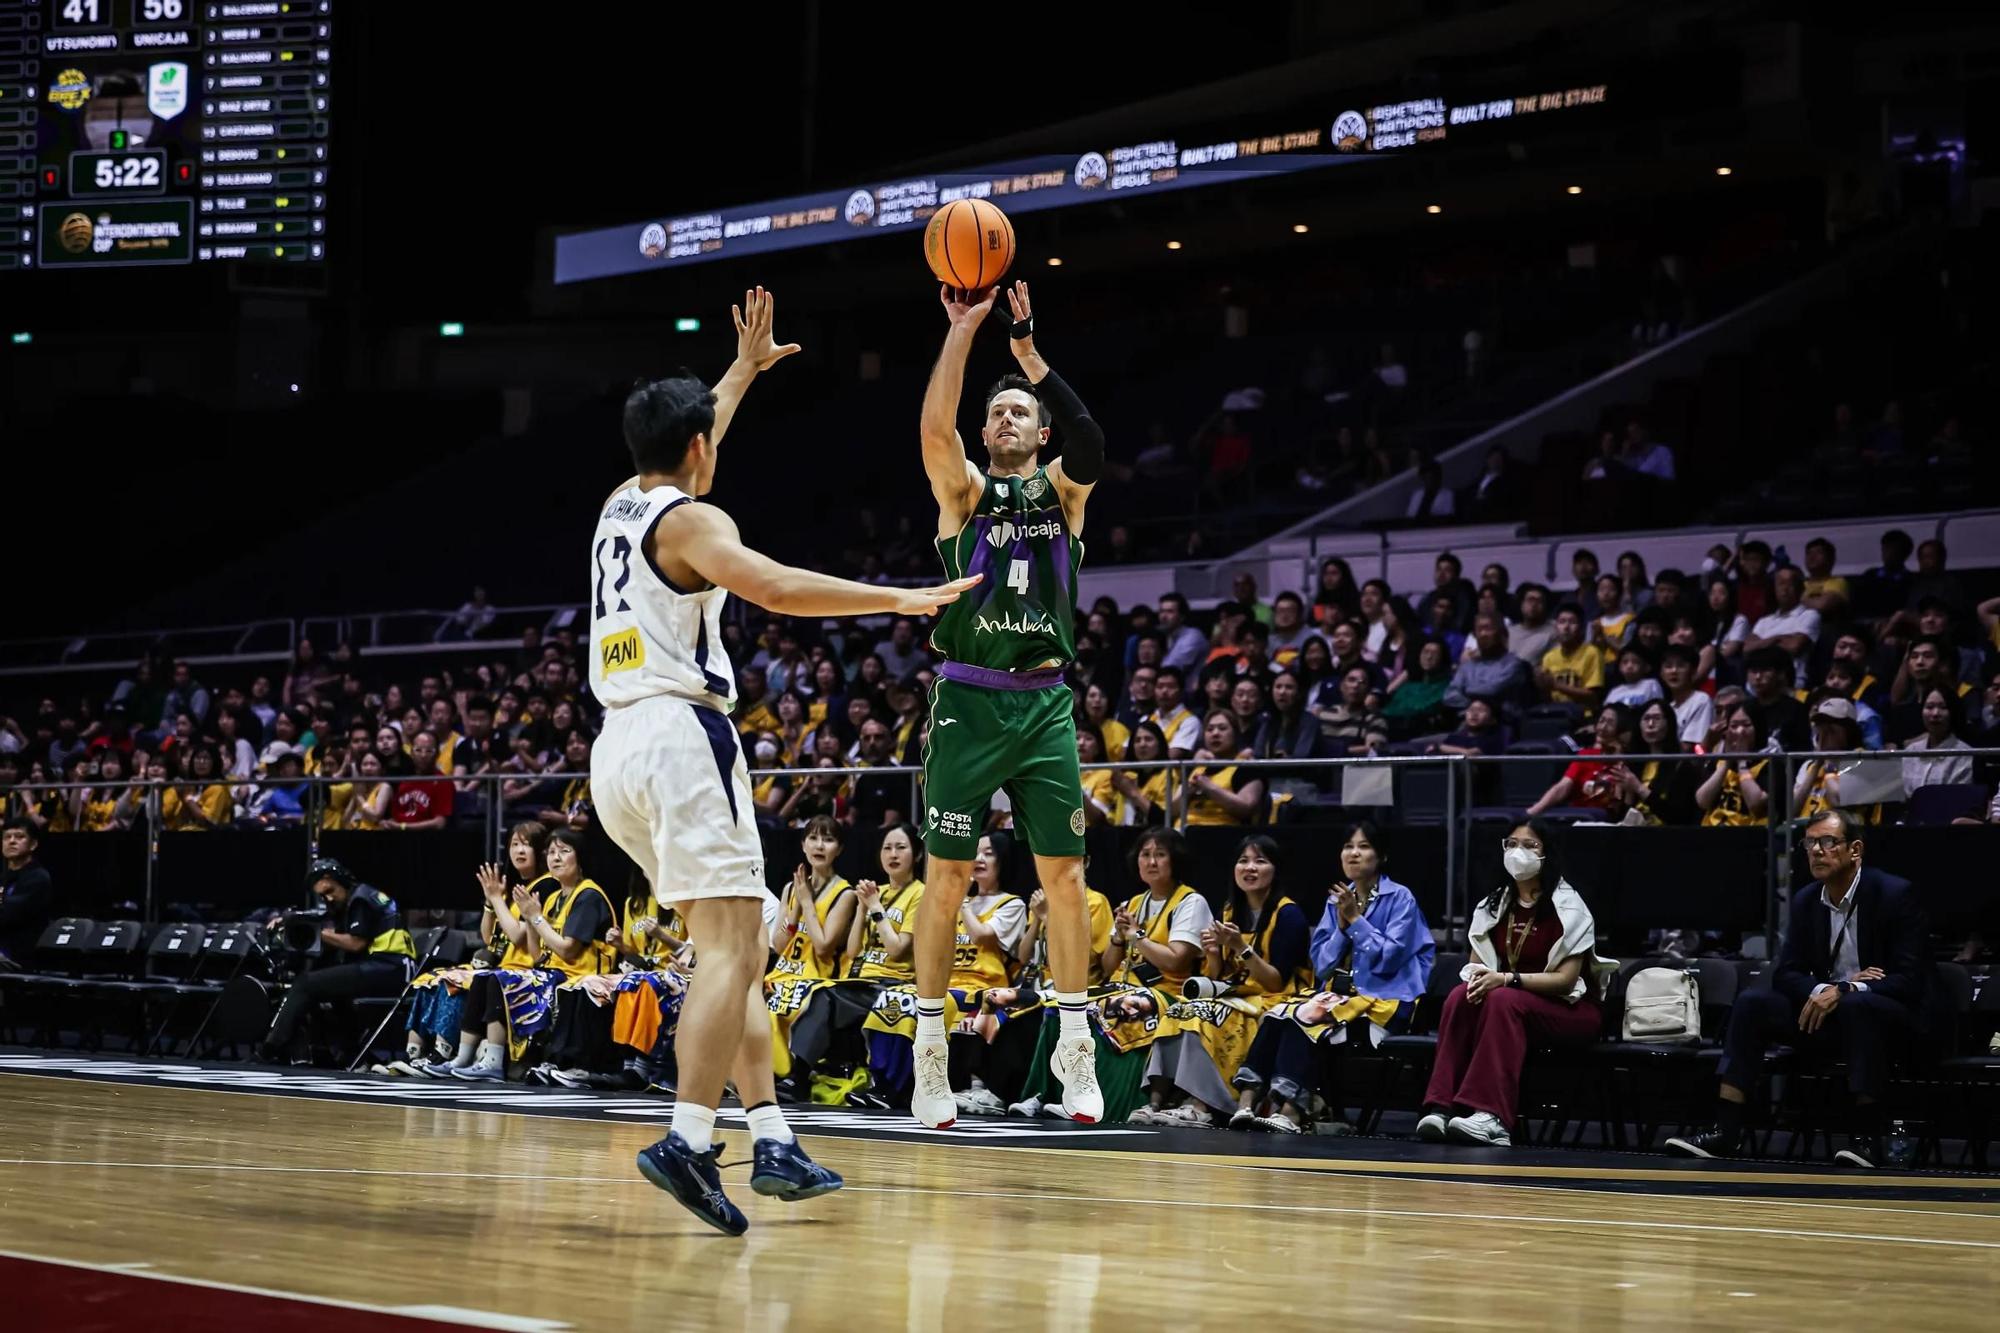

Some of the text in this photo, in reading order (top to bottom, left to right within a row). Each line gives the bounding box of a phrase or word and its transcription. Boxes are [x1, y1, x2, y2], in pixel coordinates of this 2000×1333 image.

[63, 0, 98, 22] 41
[143, 0, 182, 20] 56
[133, 31, 189, 46] UNICAJA
[1487, 100, 1513, 118] FOR
[95, 157, 160, 188] 5:22
[1007, 559, 1029, 595] 4
[974, 611, 1057, 636] Andalucía
[941, 820, 971, 831] DEL SOL
[943, 811, 972, 823] COSTA
[791, 937, 804, 960] 6
